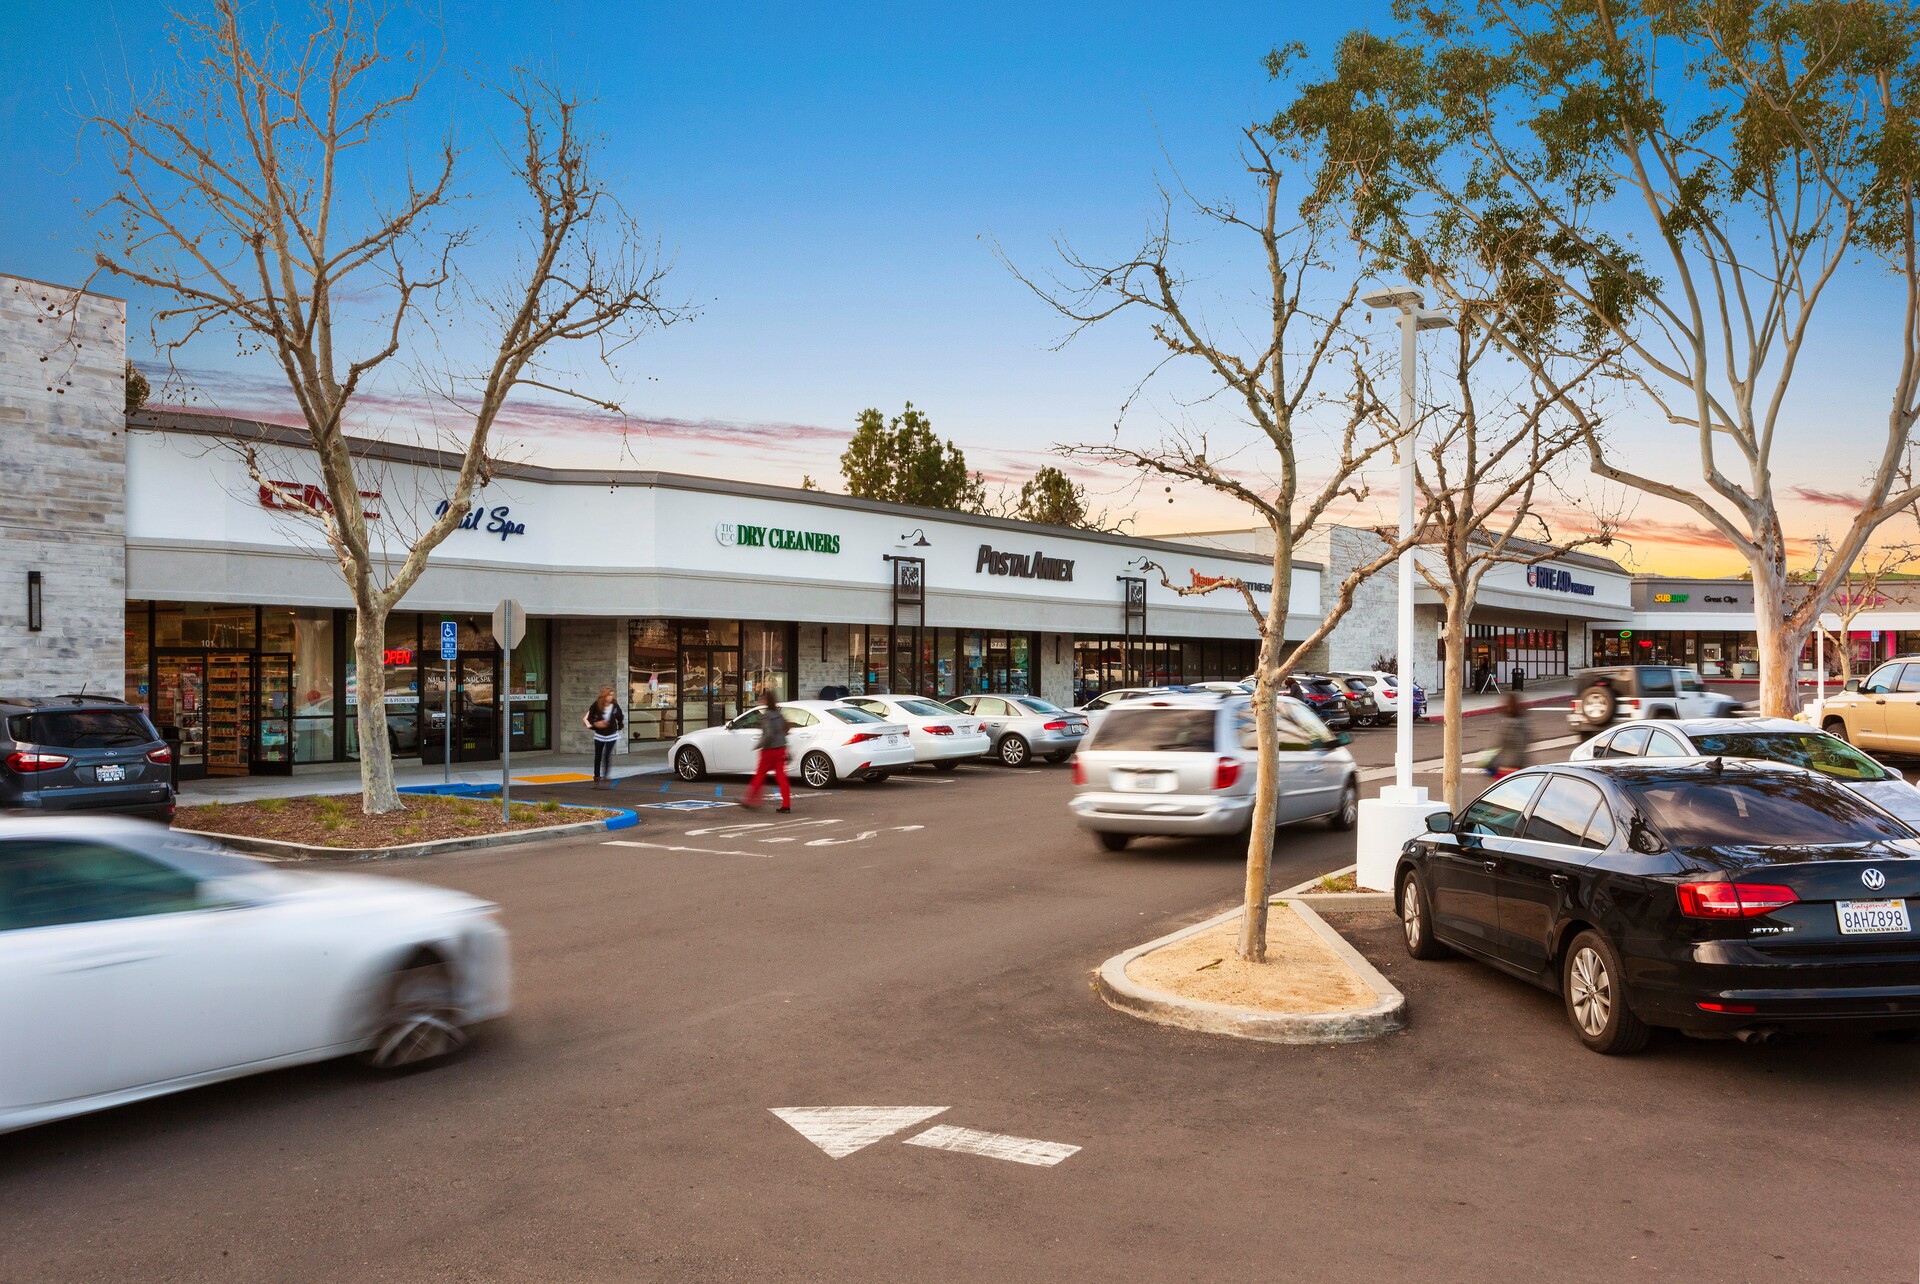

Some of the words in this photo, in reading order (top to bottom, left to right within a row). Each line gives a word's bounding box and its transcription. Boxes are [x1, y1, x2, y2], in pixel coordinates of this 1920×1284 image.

[486, 506, 525, 541] Spa
[721, 523, 734, 532] TIC
[737, 524, 767, 547] DRY
[768, 528, 840, 554] CLEANERS
[1536, 565, 1557, 591] RITE
[1556, 569, 1572, 593] AID
[1654, 593, 1690, 603] SUBWAY
[1704, 595, 1722, 603] Great
[1723, 595, 1738, 604] Clips
[201, 640, 215, 648] 101
[871, 638, 887, 647] FedEx
[384, 650, 411, 664] OPEN
[1851, 902, 1892, 912] California
[1844, 910, 1903, 929] 8AHZ898
